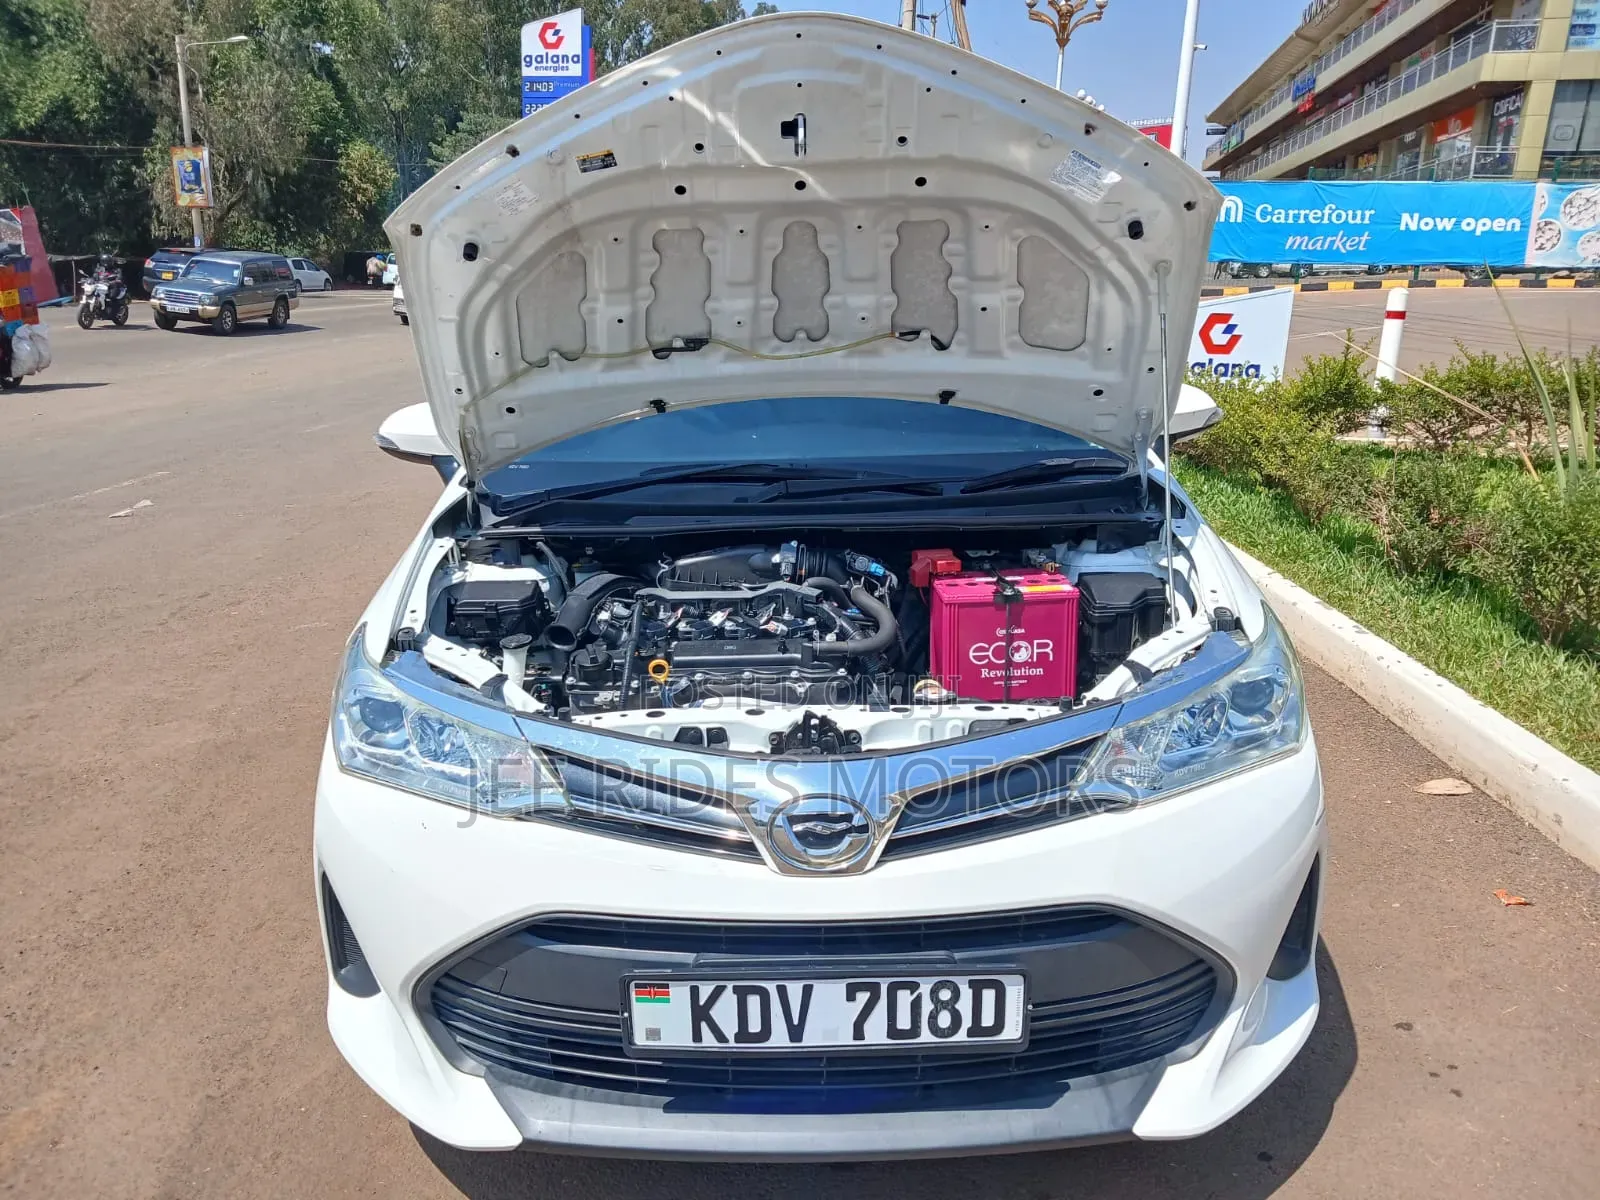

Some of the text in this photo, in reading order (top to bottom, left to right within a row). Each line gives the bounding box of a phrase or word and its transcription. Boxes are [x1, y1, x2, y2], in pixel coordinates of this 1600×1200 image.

[523, 51, 581, 68] galana
[534, 63, 569, 72] energies
[1255, 203, 1375, 224] Carrefour
[1400, 212, 1521, 236] Now open
[1285, 230, 1371, 253] market
[1190, 358, 1260, 379] alana
[690, 983, 814, 1044] KDV
[846, 978, 1006, 1041] 708D
